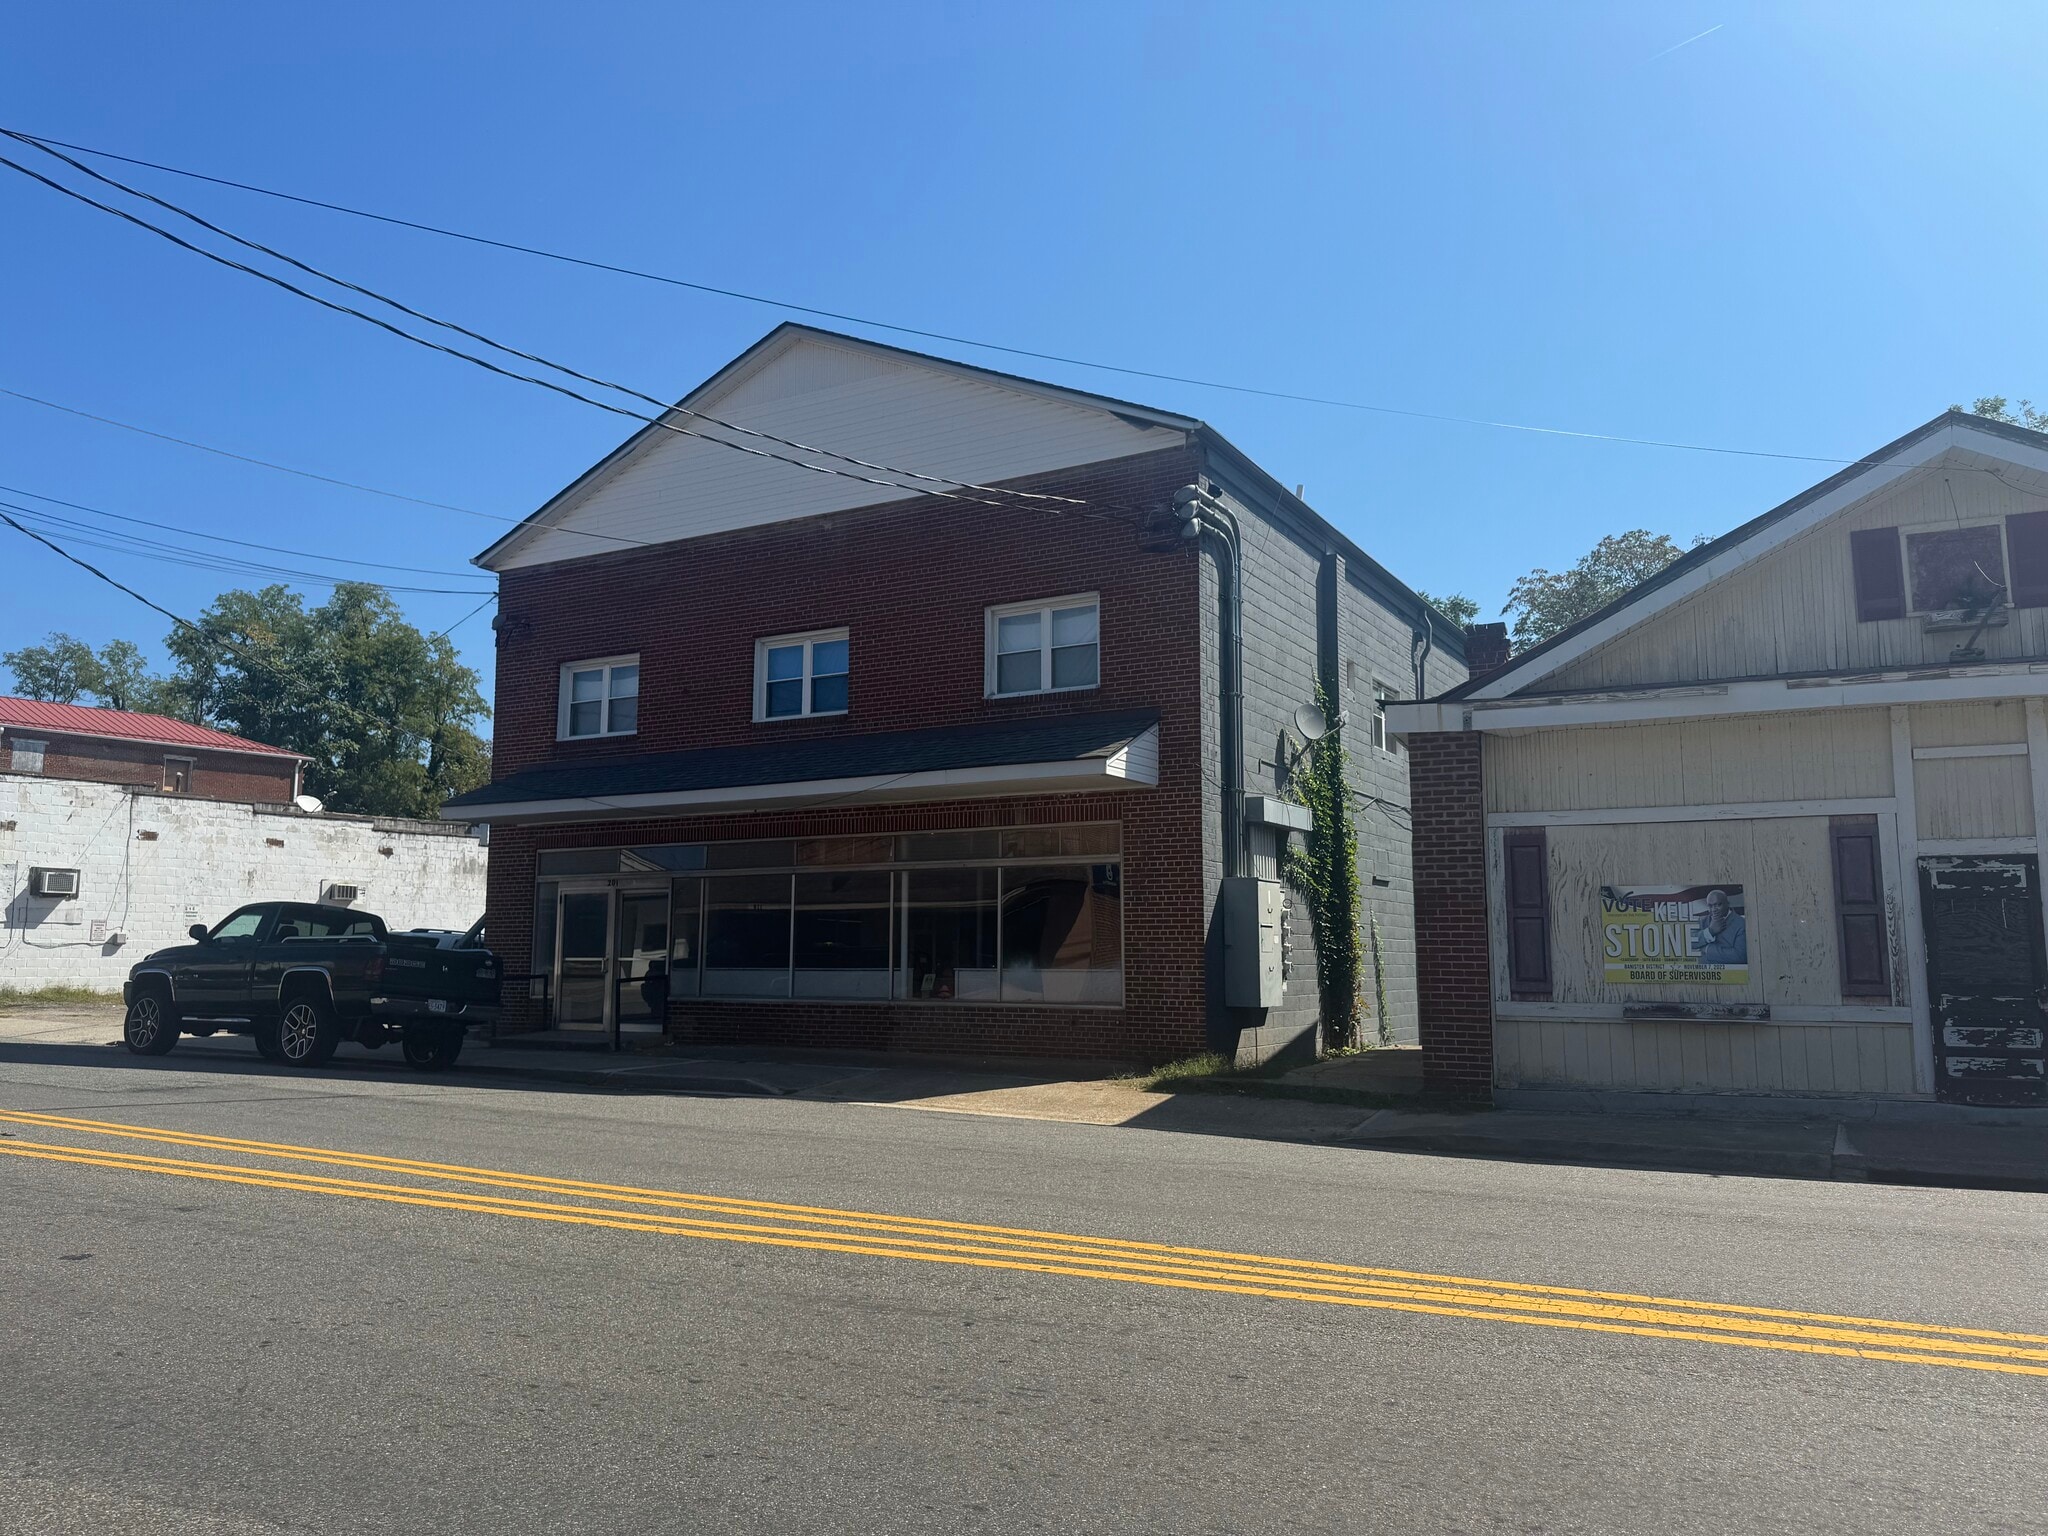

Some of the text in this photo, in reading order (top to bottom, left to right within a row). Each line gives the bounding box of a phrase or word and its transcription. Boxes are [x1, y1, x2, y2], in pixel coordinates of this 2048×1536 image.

[607, 879, 619, 887] 201
[1602, 898, 1652, 913] VOTE
[1654, 901, 1700, 922] KELL
[1605, 923, 1702, 957] STONE
[1630, 970, 1722, 981] BOARD OF SUPERVISORS
